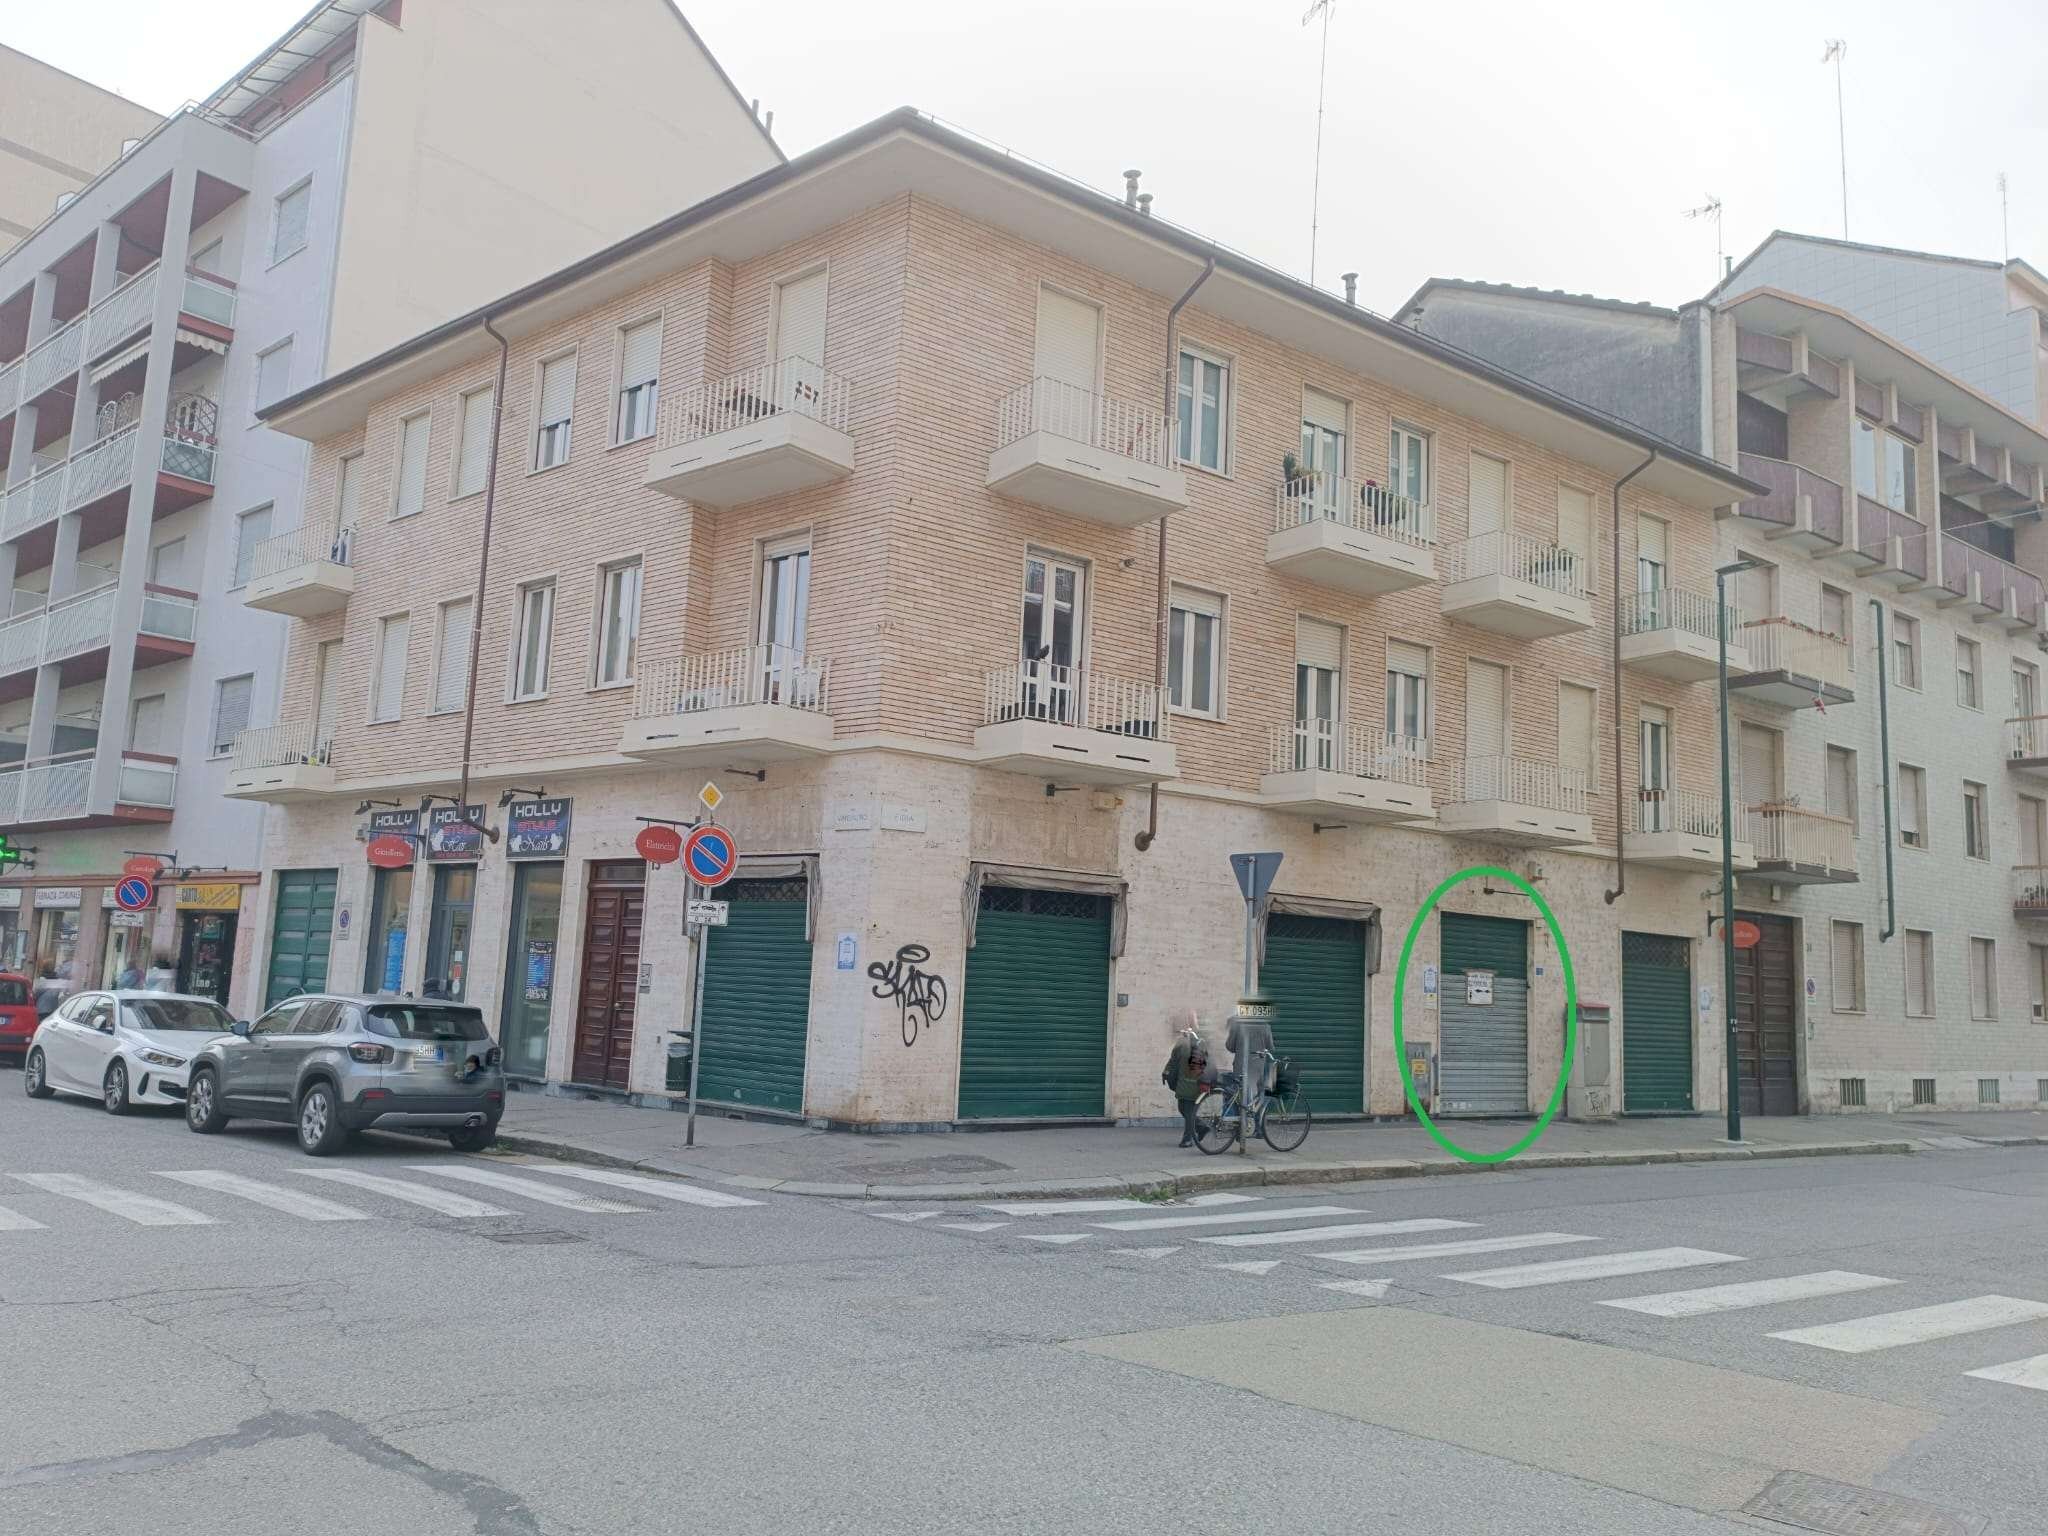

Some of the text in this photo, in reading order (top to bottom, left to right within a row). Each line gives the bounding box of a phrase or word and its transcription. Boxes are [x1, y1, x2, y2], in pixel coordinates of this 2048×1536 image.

[436, 807, 480, 823] HOLY
[515, 803, 561, 817] HOLLY
[375, 813, 413, 827] HOLLY
